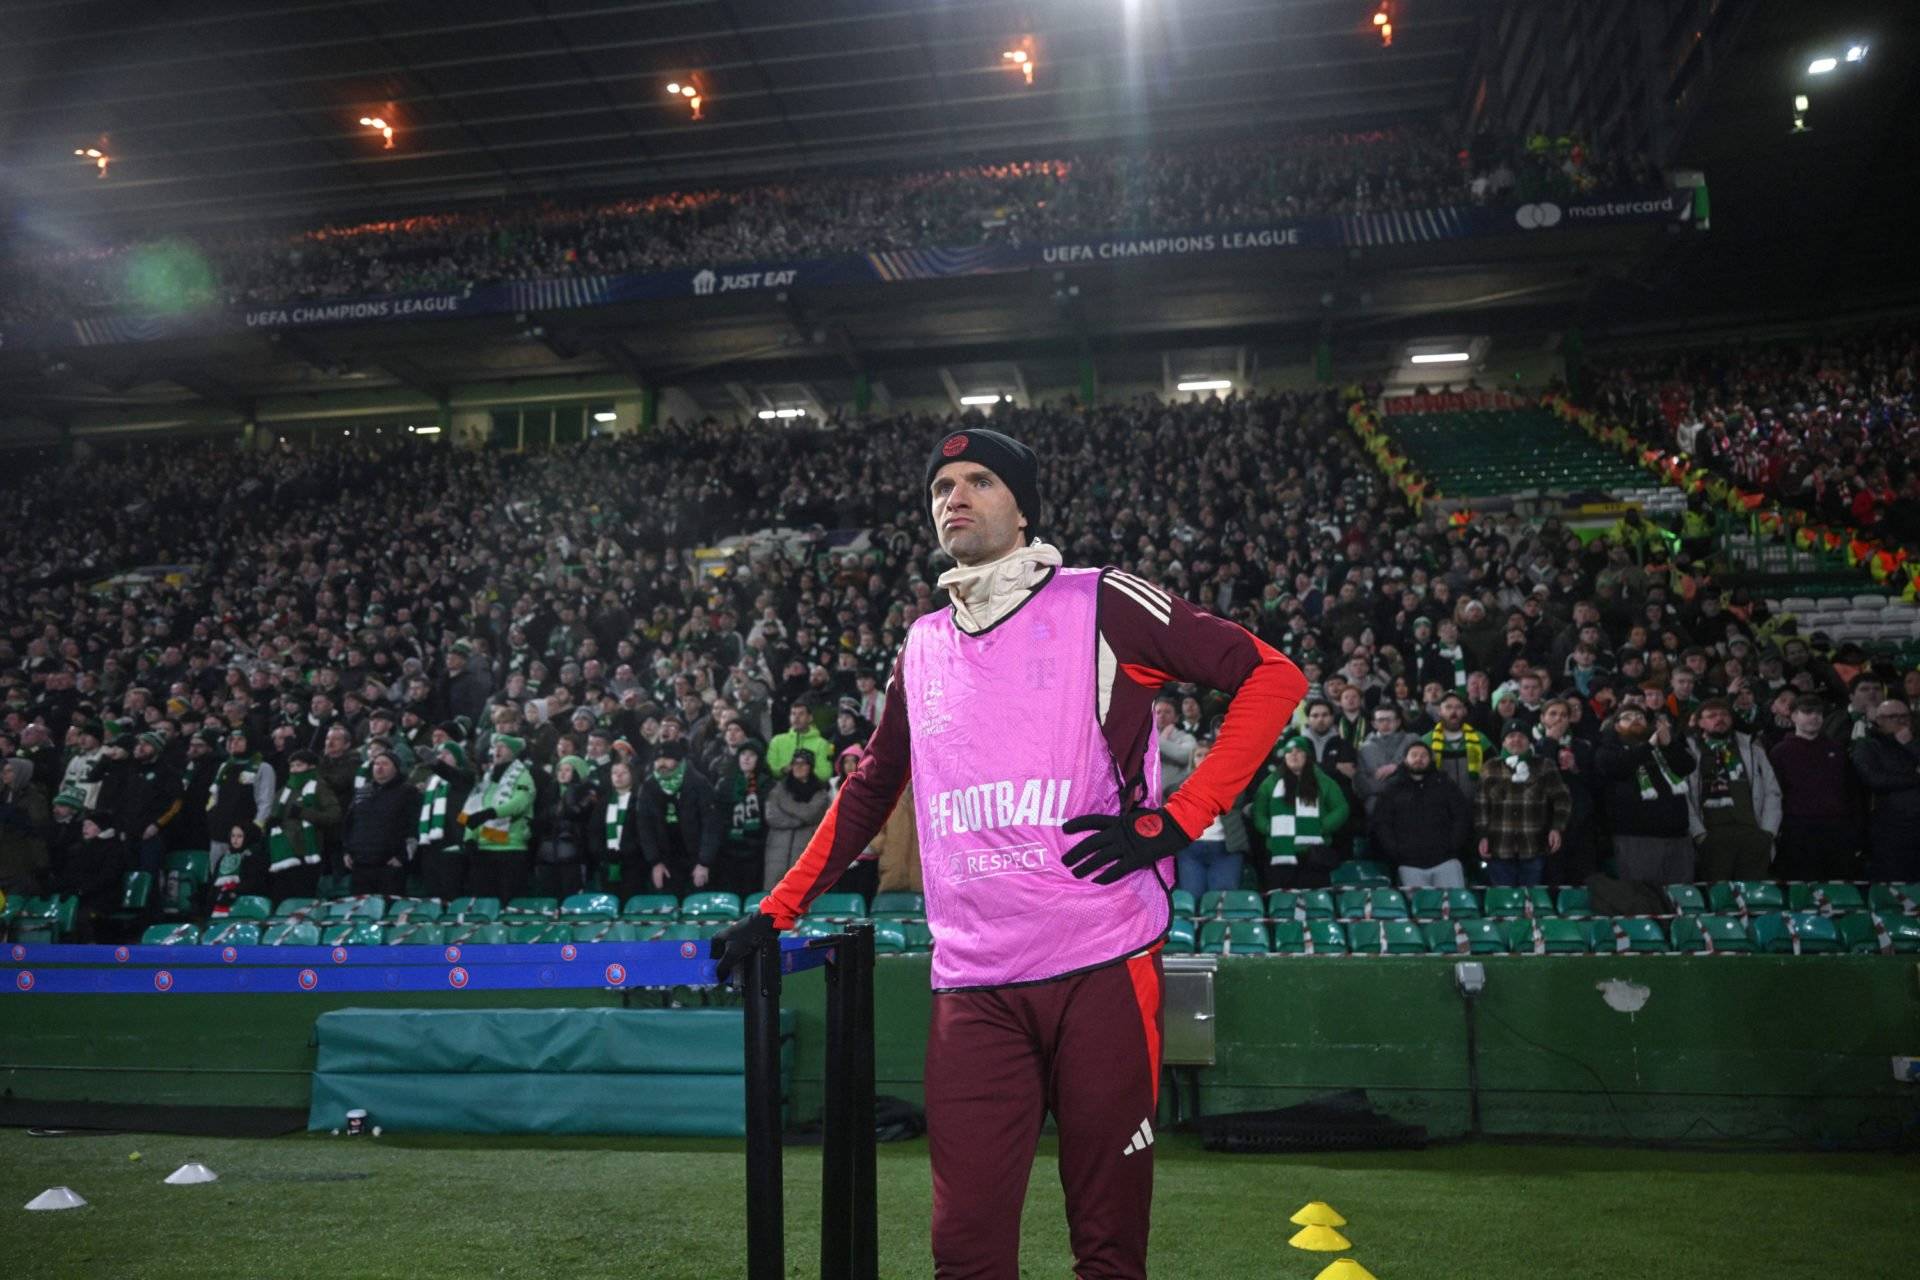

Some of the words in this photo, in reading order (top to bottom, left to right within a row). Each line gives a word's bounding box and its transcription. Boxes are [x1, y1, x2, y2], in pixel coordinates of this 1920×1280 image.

[1568, 196, 1673, 217] mastercard
[1043, 245, 1094, 263] UEFA
[1099, 234, 1215, 259] CHAMPIONS
[1222, 228, 1298, 249] LEAGUE
[719, 273, 762, 292] JUST
[763, 270, 797, 287] EAT
[246, 310, 288, 327] UEFA
[292, 301, 389, 323] CHAMPIONS
[394, 295, 458, 315] LEAGUE
[967, 848, 1048, 875] RESPECT
